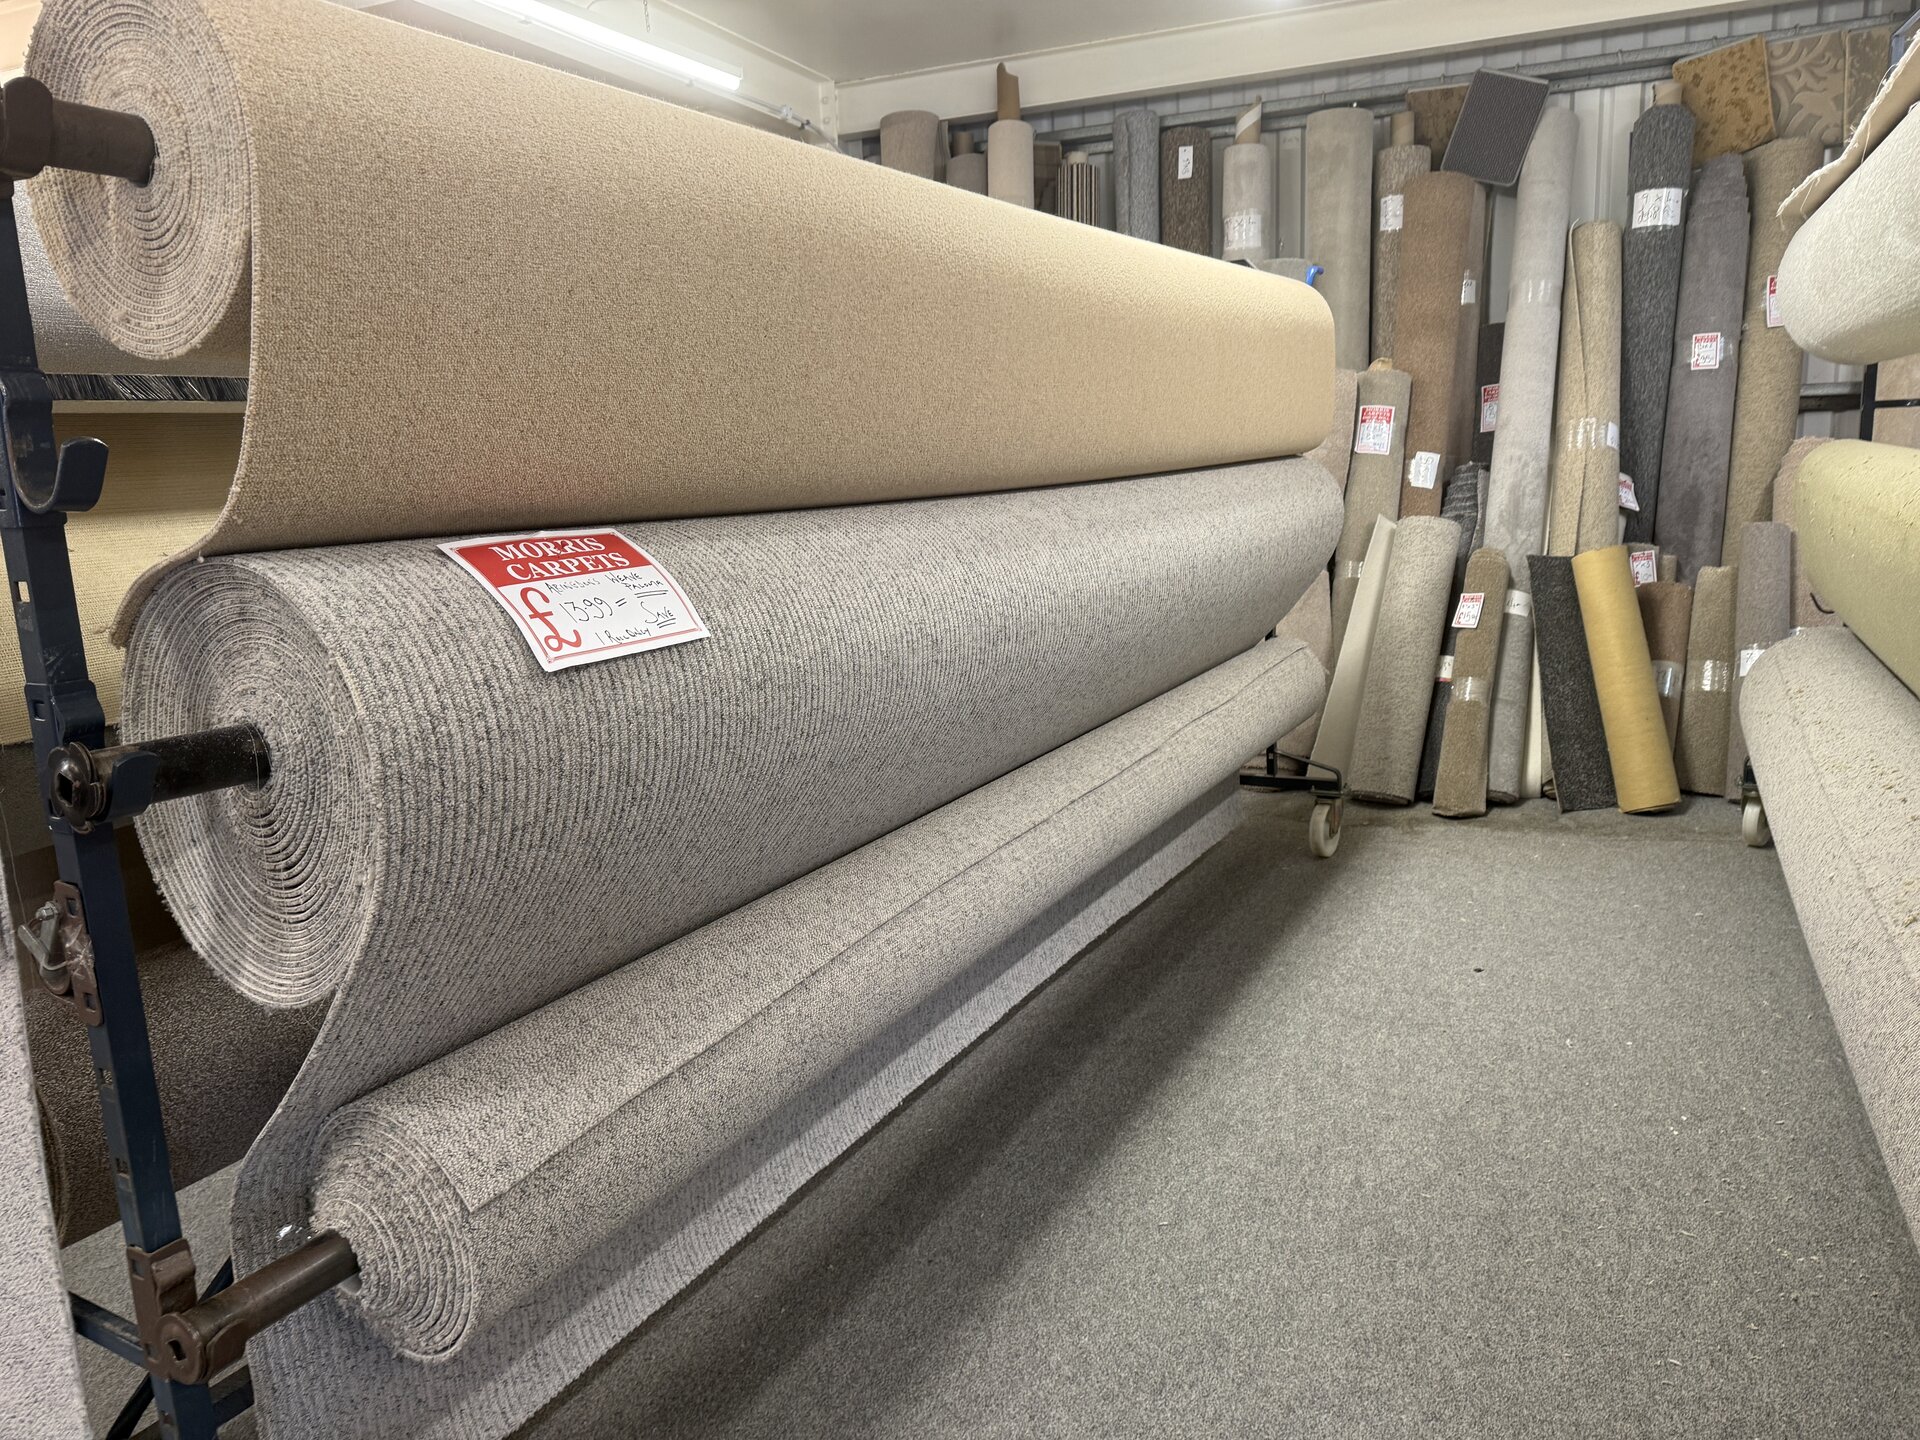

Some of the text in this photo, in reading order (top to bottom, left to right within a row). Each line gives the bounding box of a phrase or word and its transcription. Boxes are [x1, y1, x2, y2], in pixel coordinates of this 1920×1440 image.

[488, 537, 606, 562] MORRIS
[506, 552, 631, 580] CARPETS
[604, 572, 643, 584] WEAVE
[520, 586, 613, 652] £ 13.99
[640, 601, 674, 623] SAVE
